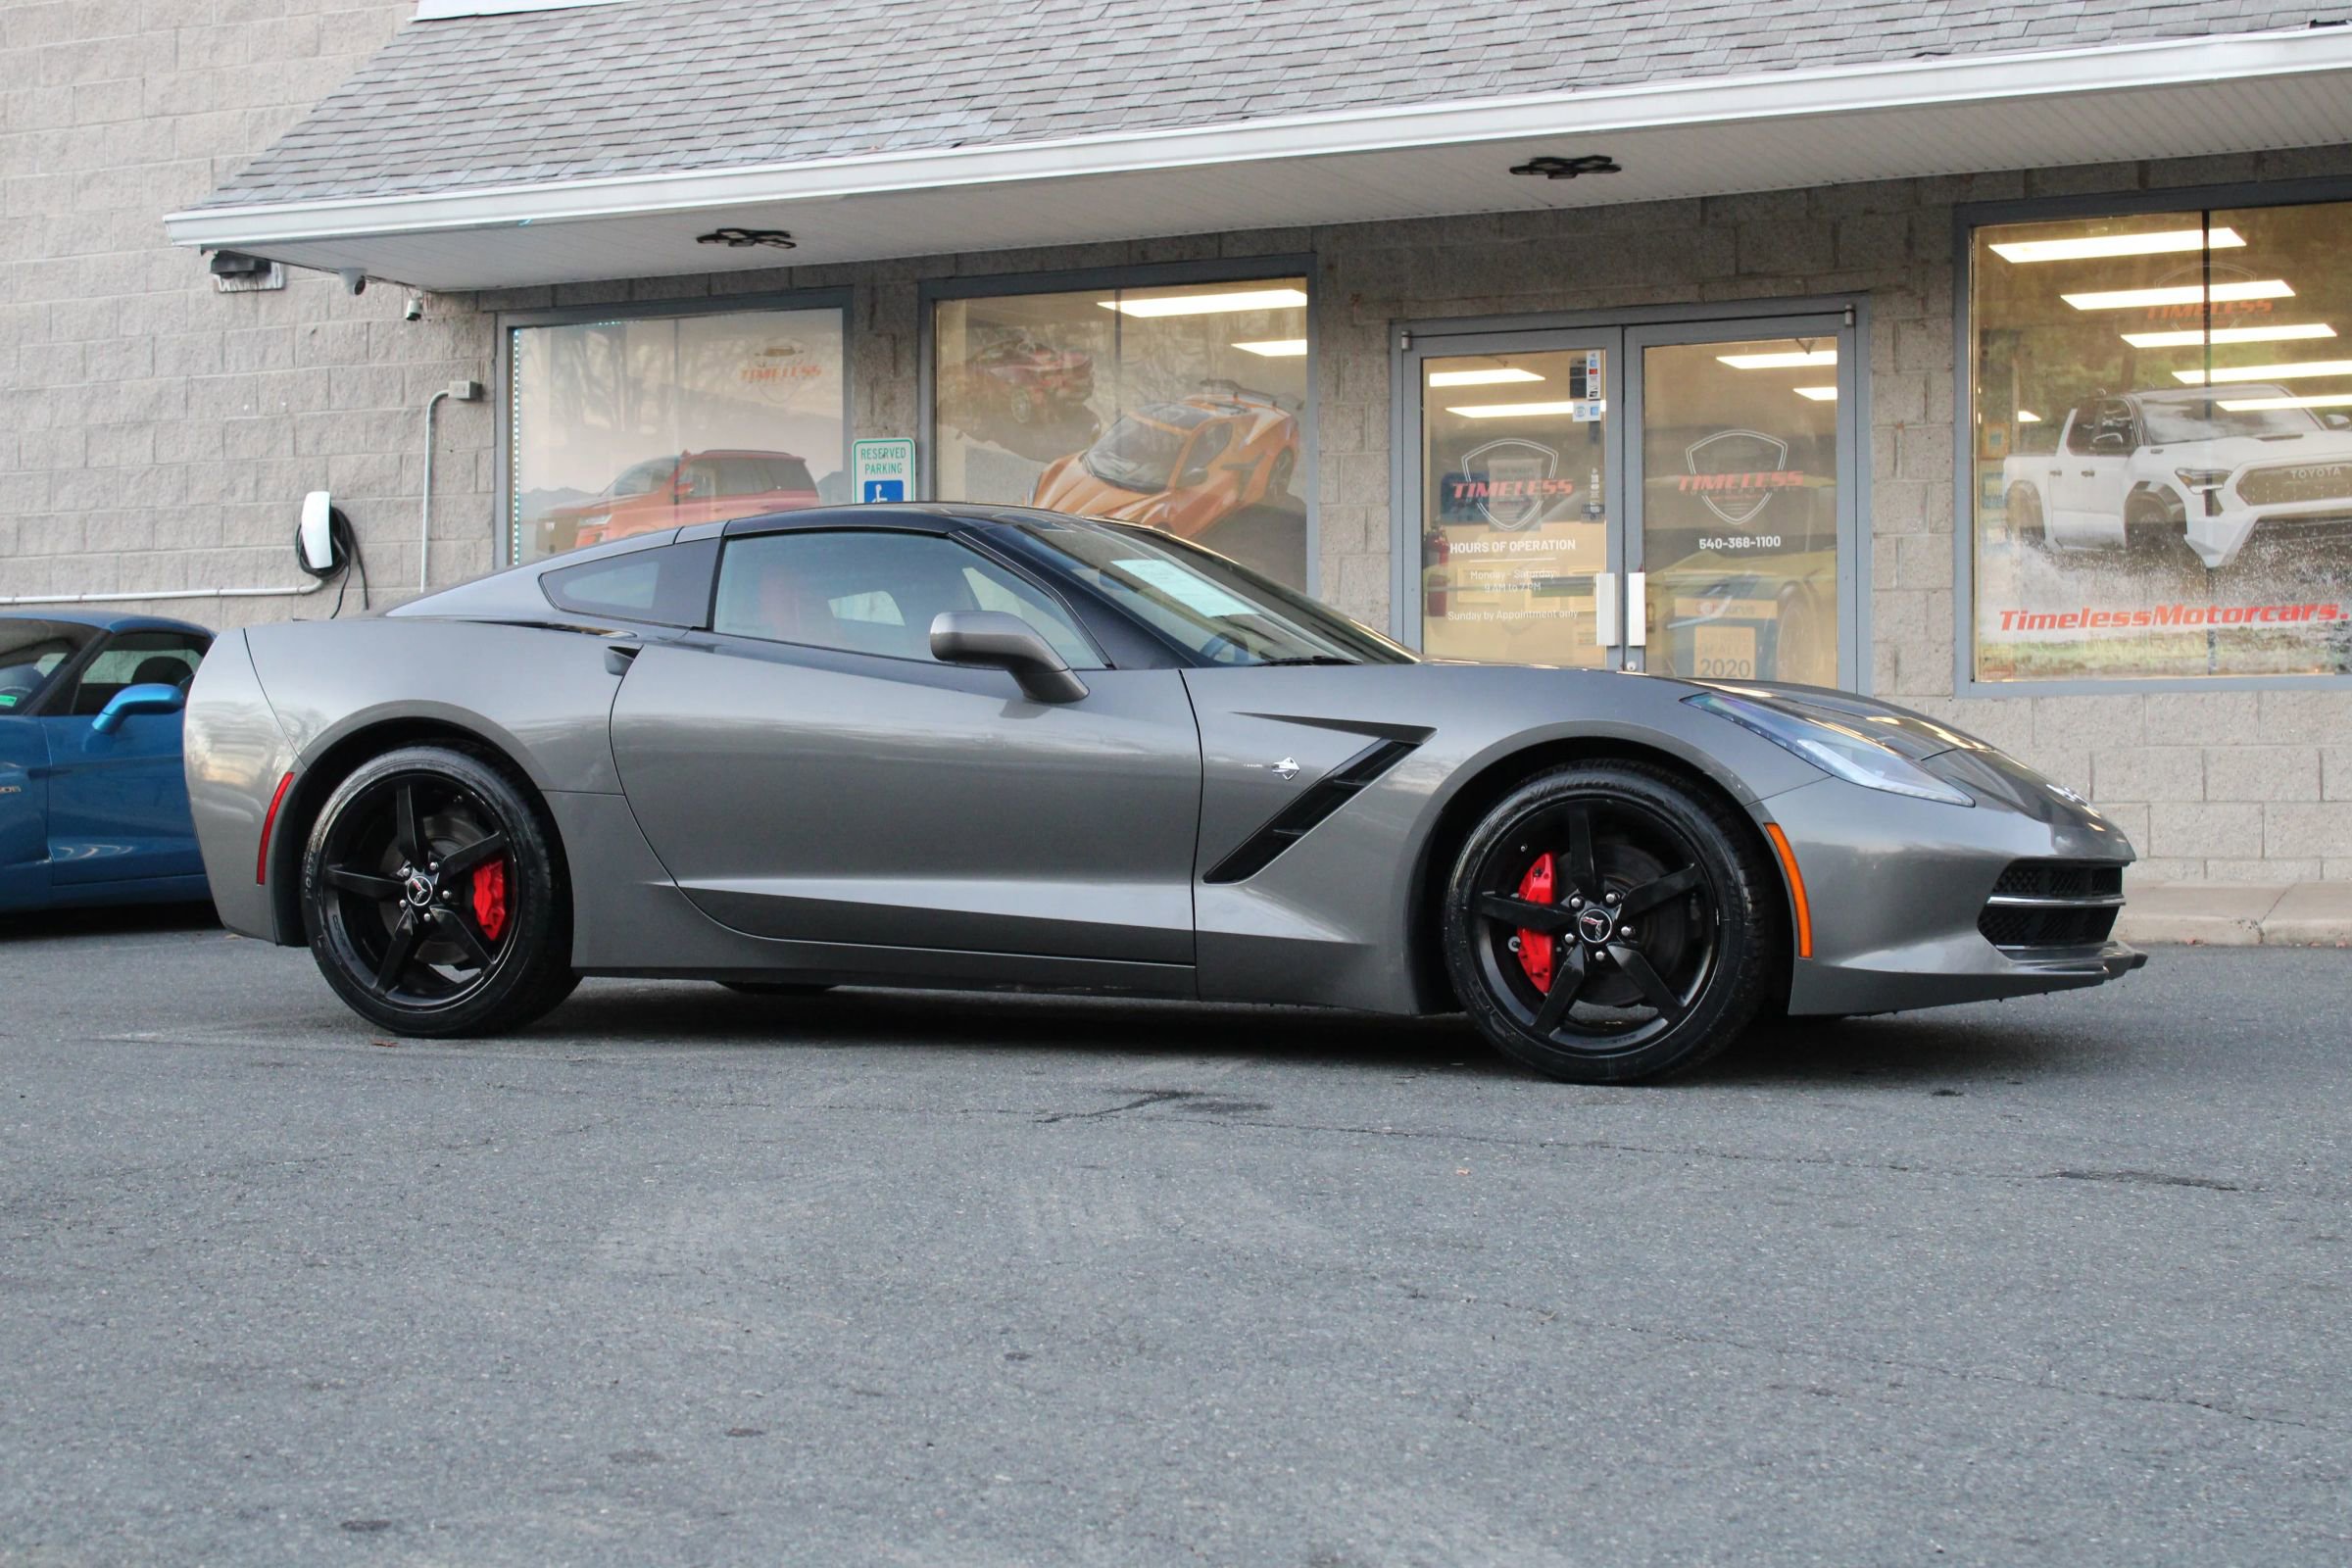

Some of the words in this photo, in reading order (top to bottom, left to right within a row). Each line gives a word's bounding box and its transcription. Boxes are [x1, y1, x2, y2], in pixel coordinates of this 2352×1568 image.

[860, 447, 906, 460] RESERVED
[864, 463, 903, 474] PARKING
[2290, 466, 2342, 479] TOYOTA
[1678, 471, 1803, 491] TIMELESS
[1452, 478, 1574, 499] TIMELESS
[1449, 542, 1490, 554] HOURS
[1492, 541, 1507, 553] OF
[1509, 539, 1576, 552] OPERATION
[1698, 536, 1782, 550] 540-368-1100
[1470, 569, 1505, 581] Monday
[1513, 568, 1554, 581] Saturday
[1447, 611, 1481, 621] Sunday
[1483, 611, 1494, 621] by
[1496, 610, 1556, 621] Appointment
[1559, 610, 1579, 619] only
[1700, 659, 1751, 678] 2020
